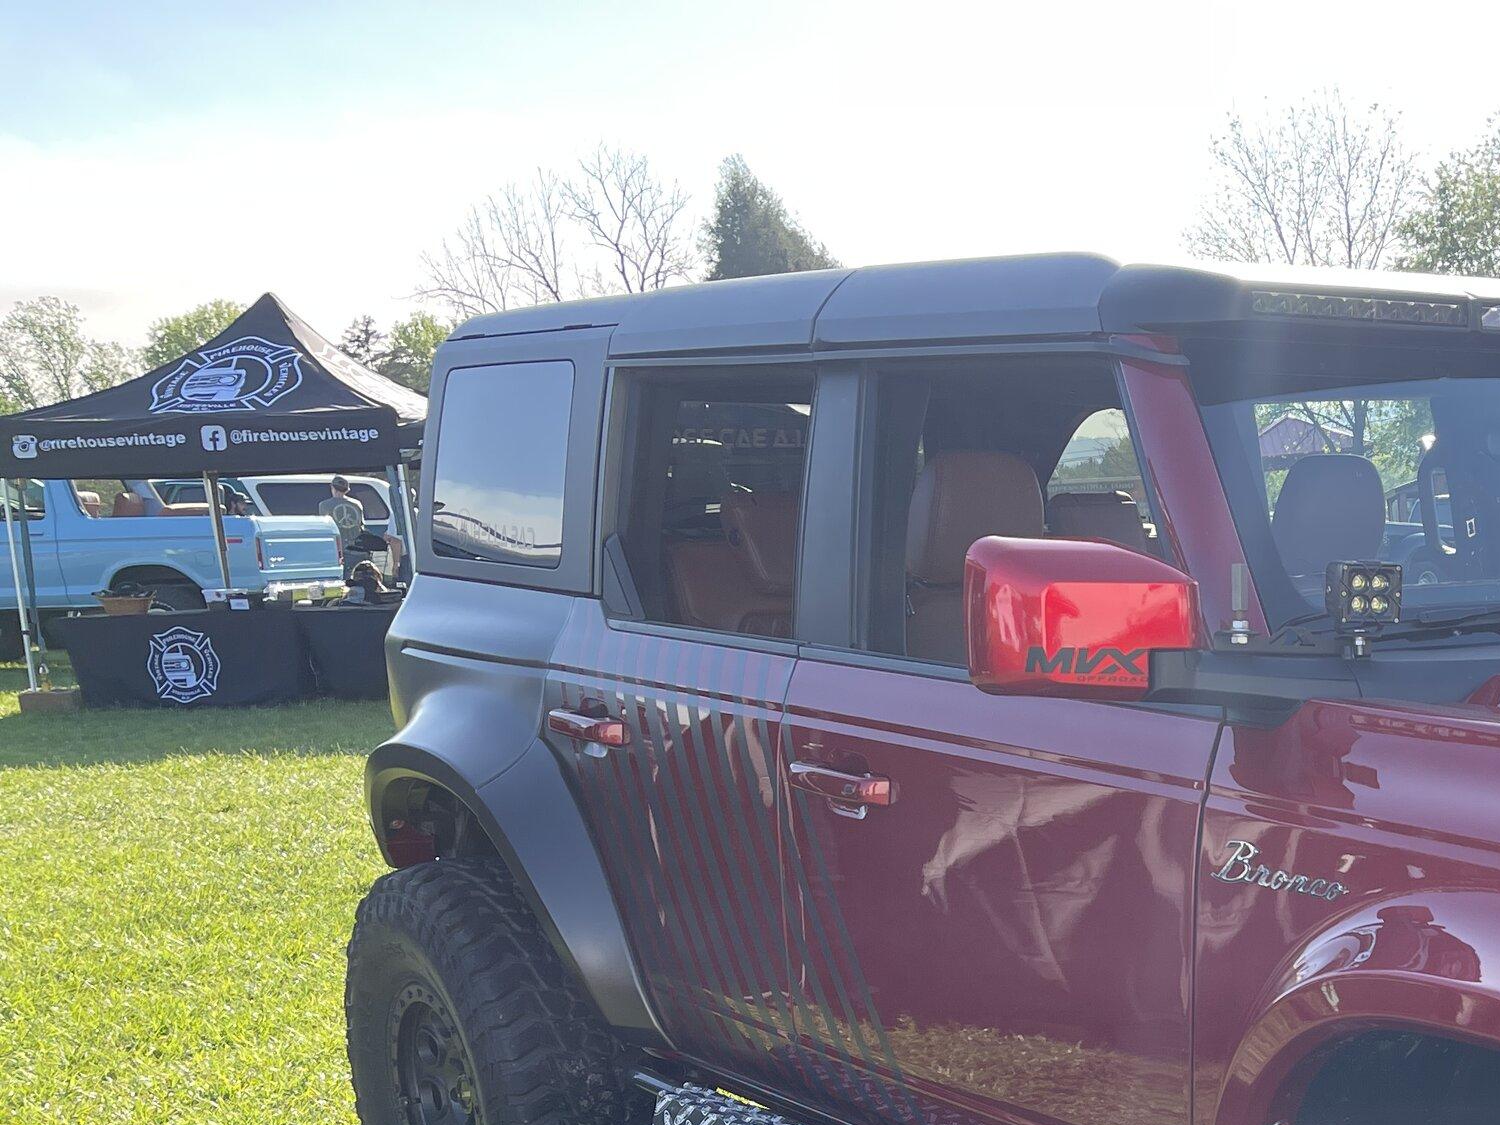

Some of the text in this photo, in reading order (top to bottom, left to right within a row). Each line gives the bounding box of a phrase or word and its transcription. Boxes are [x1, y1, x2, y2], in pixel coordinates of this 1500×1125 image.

[209, 344, 273, 360] FIREHOUSE
[229, 427, 379, 445] @firehousevintage
[1025, 646, 1149, 675] MVX
[1210, 840, 1349, 901] Bronco
